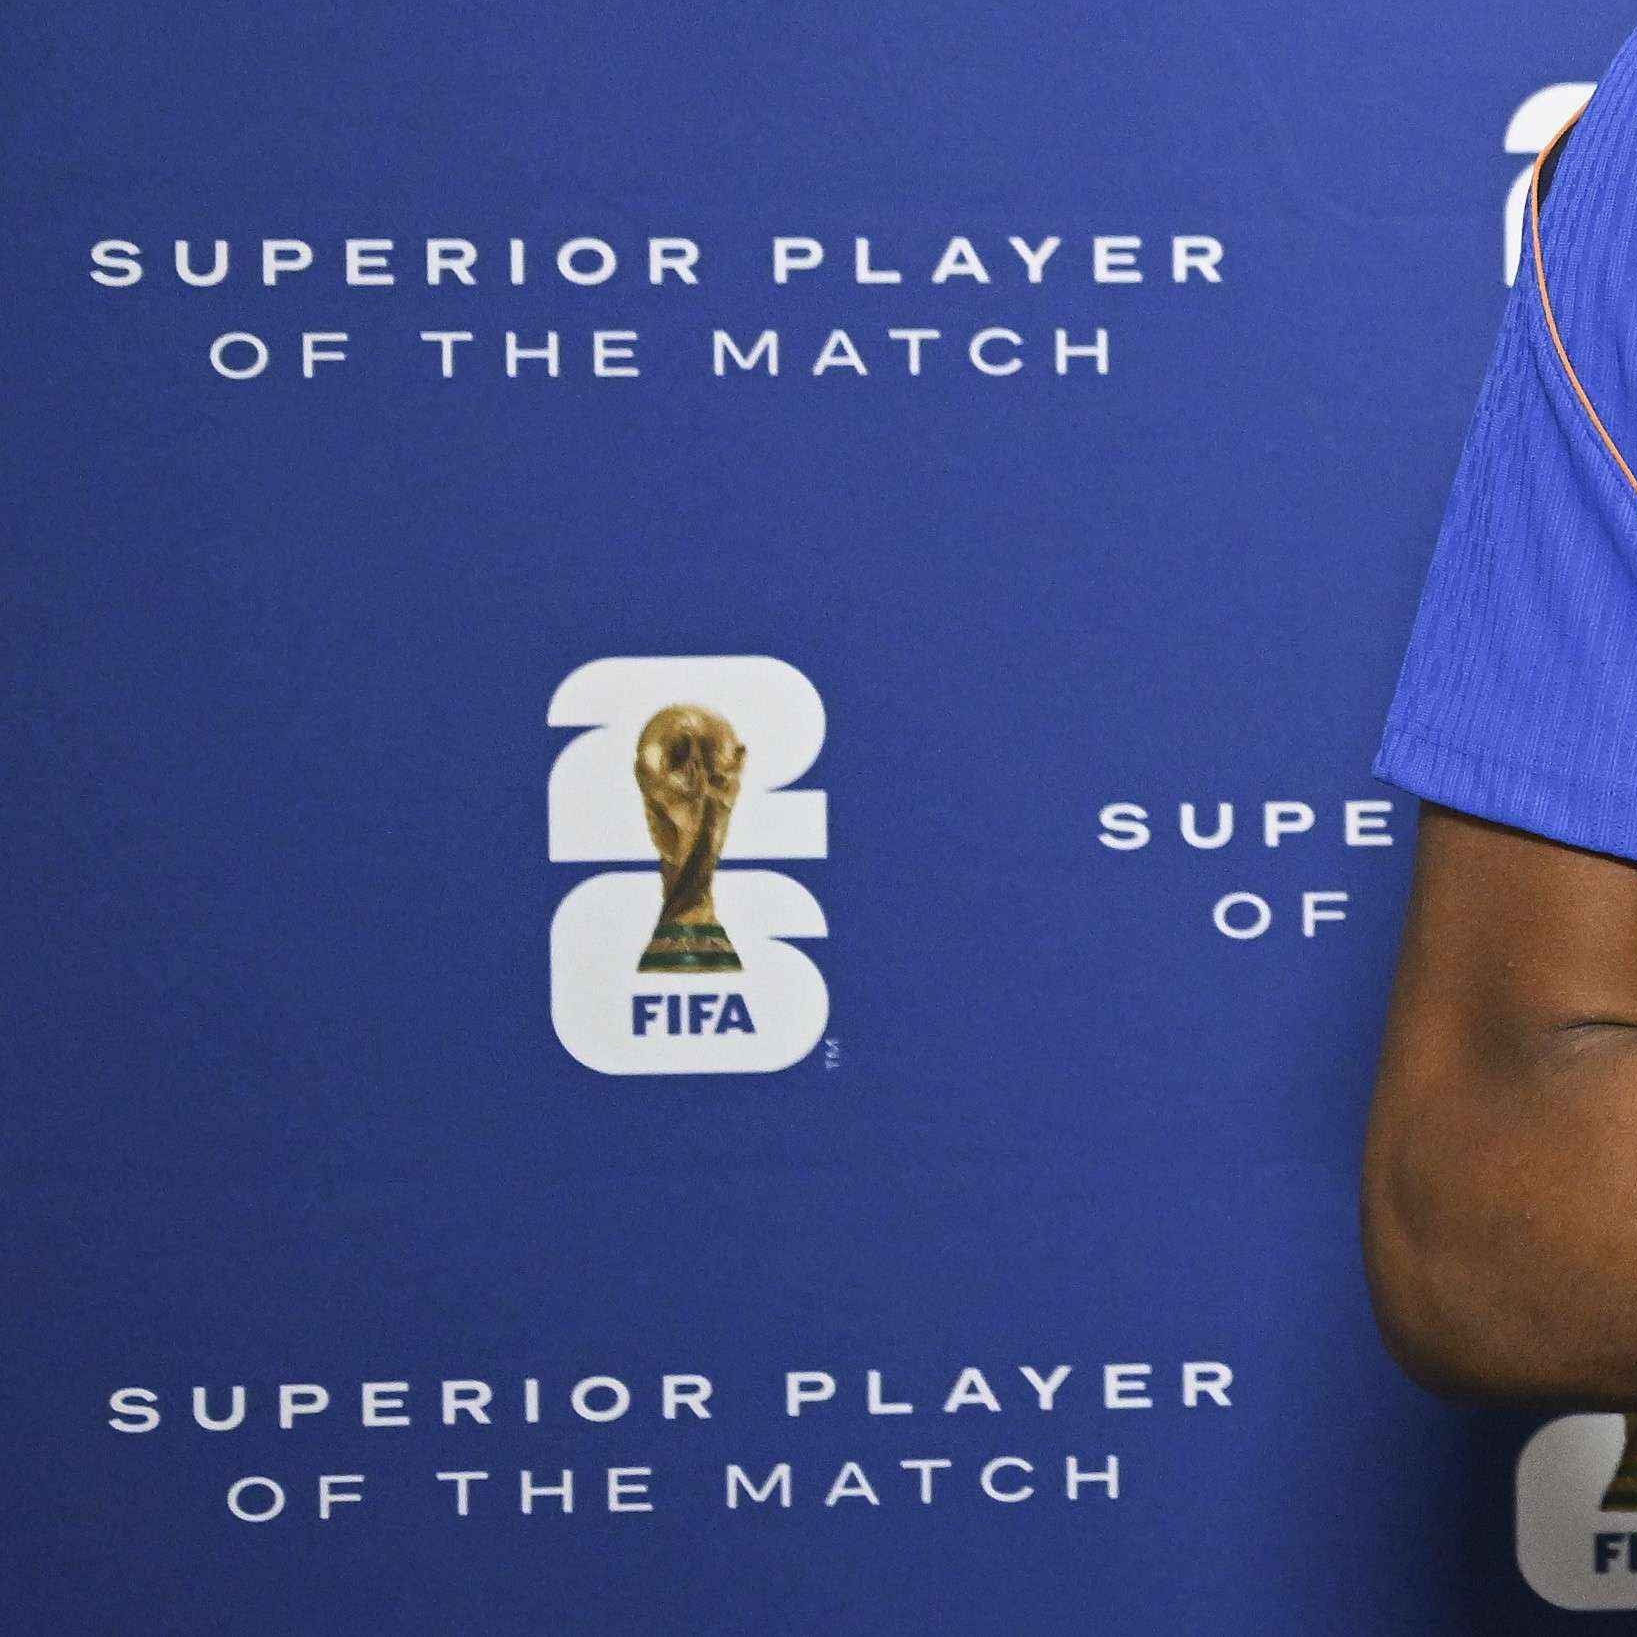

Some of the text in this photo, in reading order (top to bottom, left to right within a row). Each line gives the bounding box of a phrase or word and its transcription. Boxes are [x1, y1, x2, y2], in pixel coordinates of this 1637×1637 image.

[89, 234, 1225, 288] SUPERIOR PLAYER
[209, 326, 1110, 380] OF THE MATCH
[1097, 799, 1394, 851] SUPE
[1212, 890, 1349, 940] OF
[630, 992, 757, 1037] FIFA
[108, 1361, 1234, 1433] SUPERIOR PLAYER
[227, 1454, 1120, 1523] OF THE MATCH
